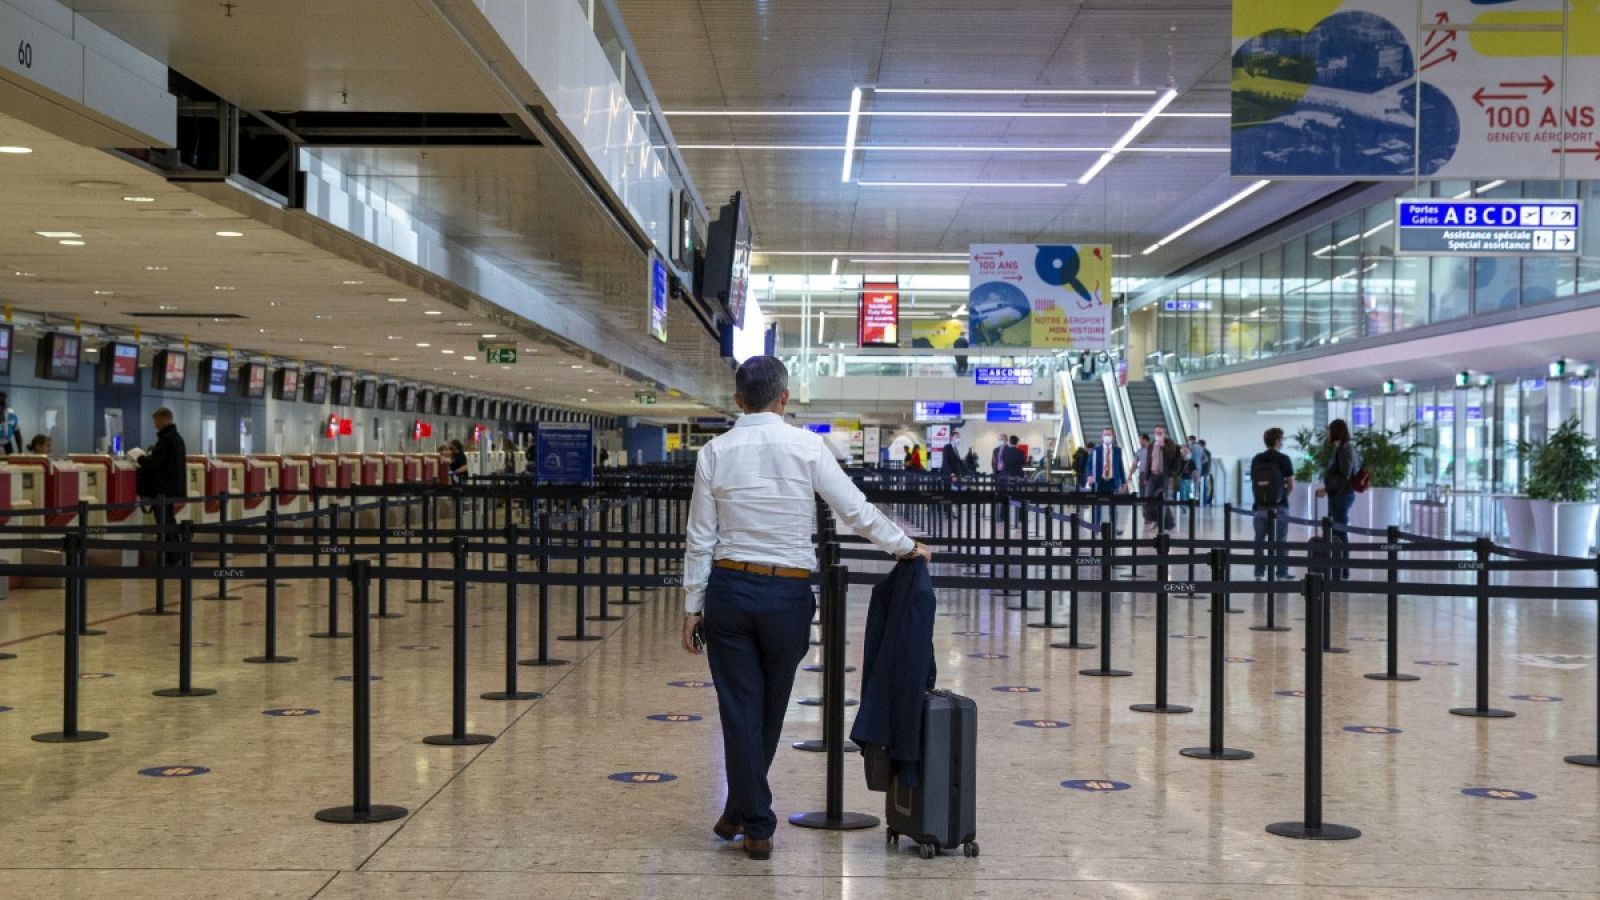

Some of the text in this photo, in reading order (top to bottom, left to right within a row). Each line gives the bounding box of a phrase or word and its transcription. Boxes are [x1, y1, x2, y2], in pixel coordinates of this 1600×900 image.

[18, 40, 32, 69] 60
[1486, 105, 1595, 128] 100 ANS
[1409, 204, 1439, 215] Portes
[1411, 215, 1439, 225] Gates
[1443, 206, 1517, 225] A B C D
[1442, 230, 1531, 242] Assistance spéciale
[1447, 240, 1531, 251] Special assistance
[979, 261, 1019, 270] 100 ANS
[1034, 316, 1060, 325] NOTRE
[1048, 326, 1105, 334] MON HISTOIRE
[988, 368, 995, 376] A
[1163, 582, 1196, 592] GENÈVE
